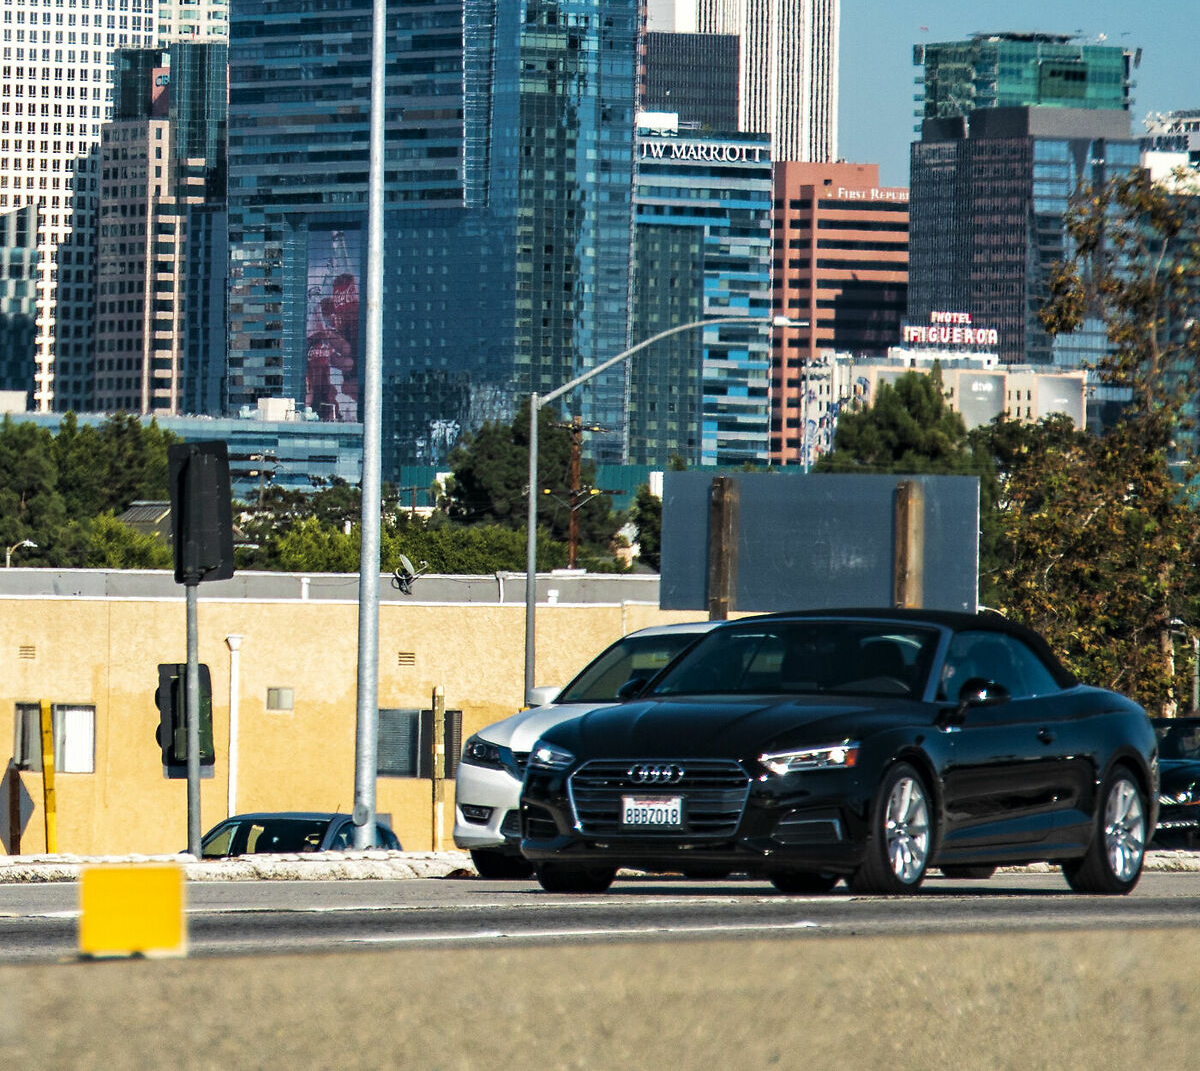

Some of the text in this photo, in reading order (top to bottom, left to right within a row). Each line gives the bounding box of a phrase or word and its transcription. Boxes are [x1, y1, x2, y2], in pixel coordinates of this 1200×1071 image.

[641, 141, 765, 163] JW MARRIOTT
[838, 187, 866, 199] FIRST
[933, 311, 972, 324] HOTEL
[905, 325, 998, 345] FIGUEROA
[625, 808, 679, 825] 8BBZ018
